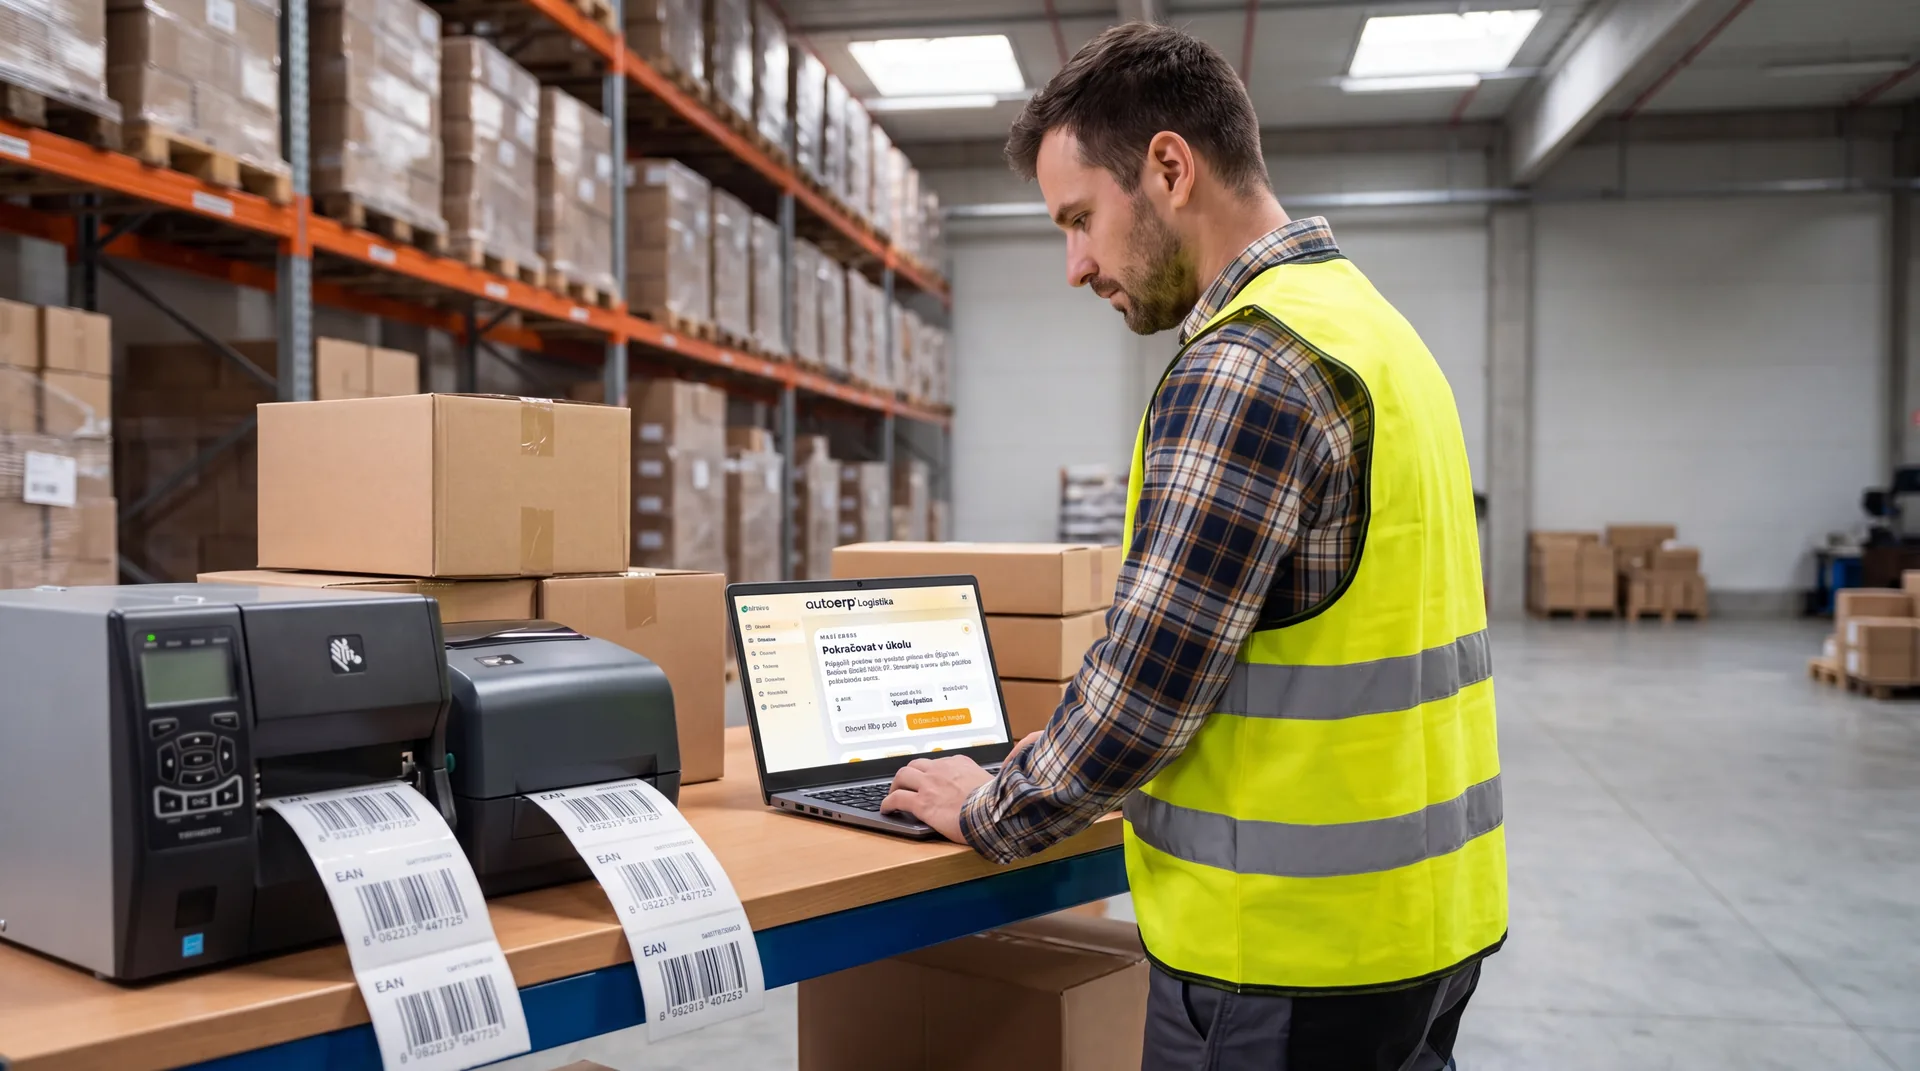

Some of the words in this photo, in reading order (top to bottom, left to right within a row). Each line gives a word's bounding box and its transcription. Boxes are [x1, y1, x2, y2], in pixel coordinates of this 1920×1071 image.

[857, 597, 894, 609] Logistika
[822, 642, 877, 655] Pokračovat
[878, 643, 884, 651] v
[885, 639, 912, 650] úkolu
[540, 792, 566, 801] EAN
[596, 852, 622, 864] EAN
[335, 868, 364, 883] EAN
[628, 905, 636, 914] 8
[363, 936, 371, 946] 8
[643, 941, 667, 957] EAN
[375, 977, 404, 993] EAN
[659, 1011, 666, 1021] 8
[710, 990, 743, 1006] 407253
